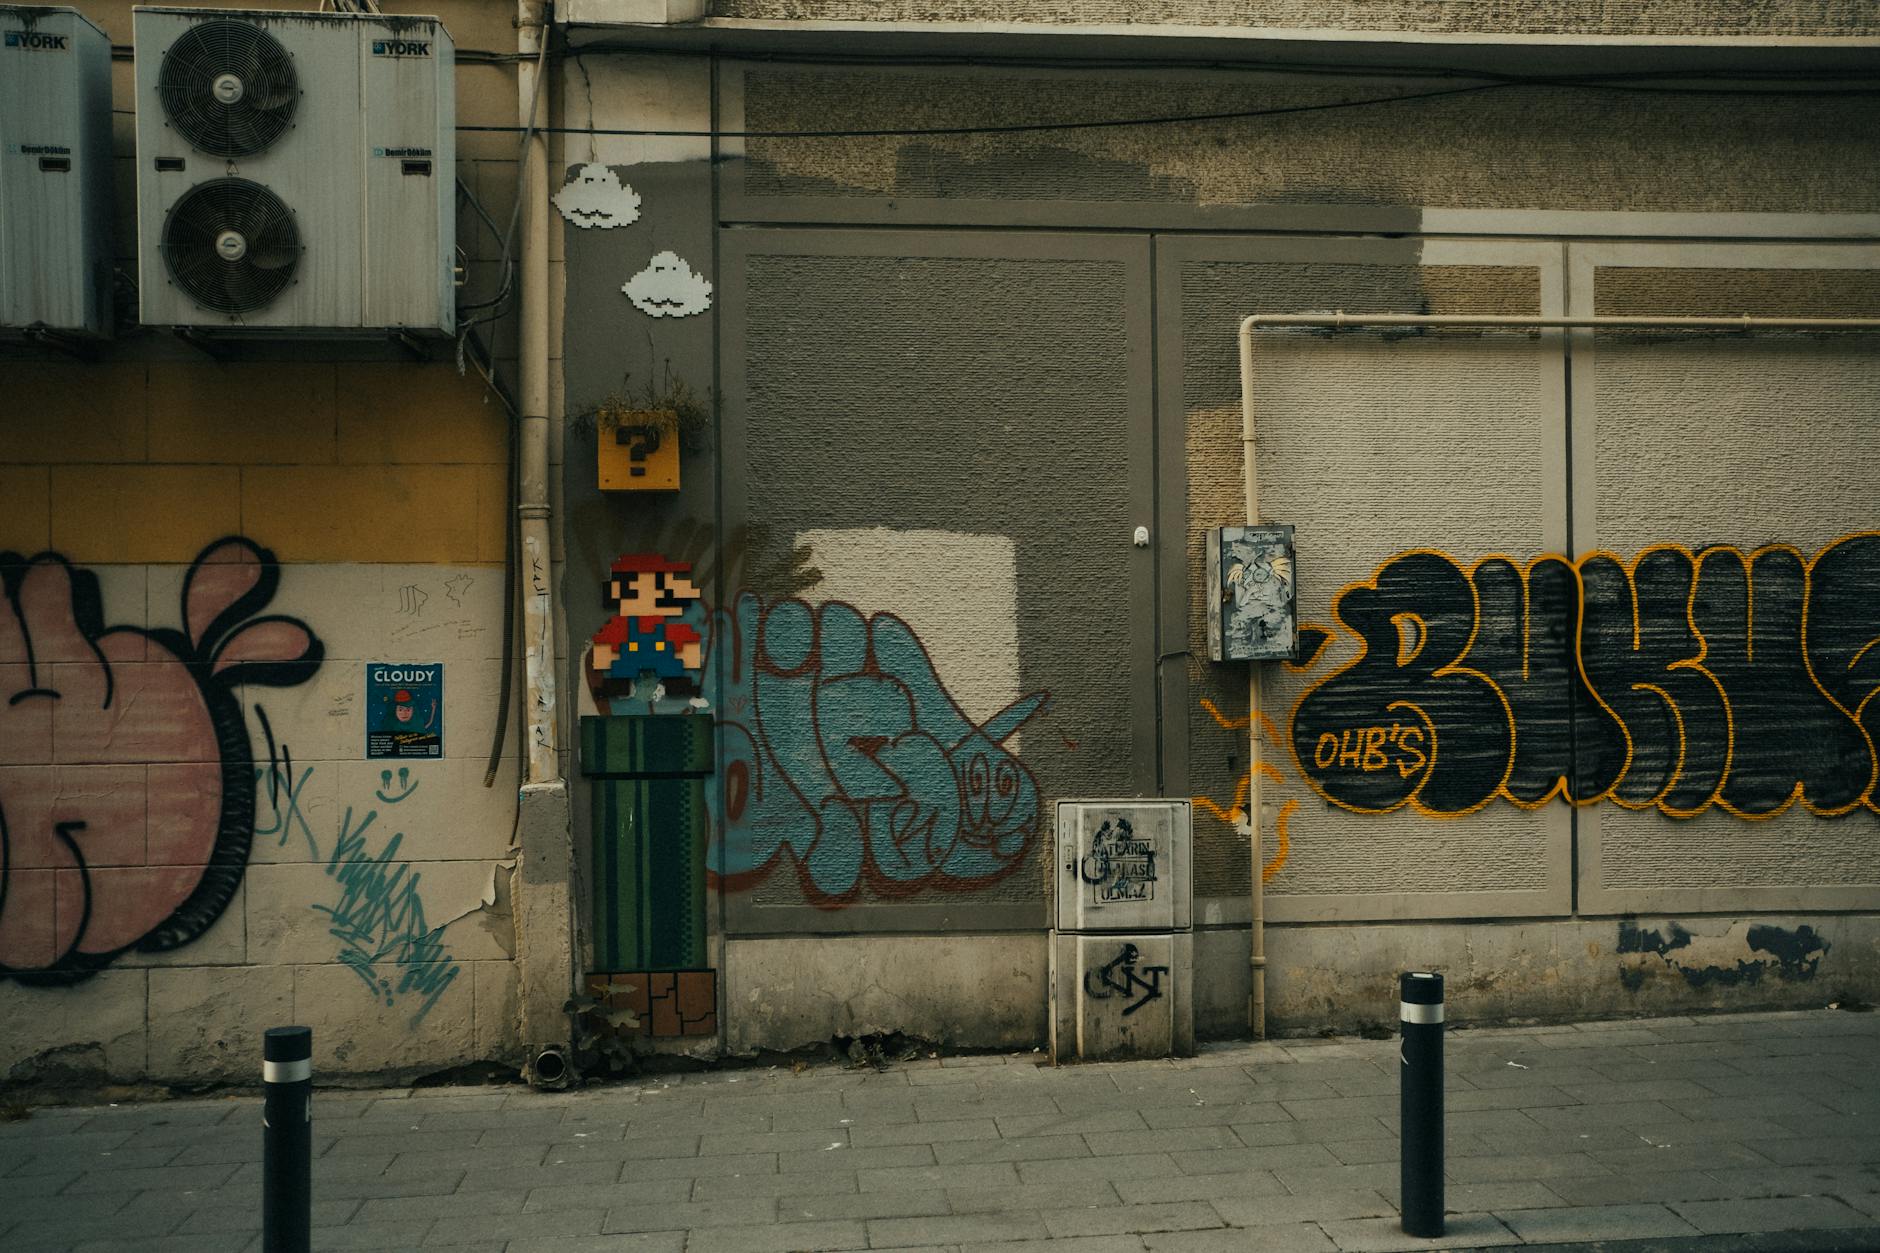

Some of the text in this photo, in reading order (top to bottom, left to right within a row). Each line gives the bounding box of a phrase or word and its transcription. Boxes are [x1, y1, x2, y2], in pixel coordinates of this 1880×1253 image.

[19, 34, 66, 50] YORK
[385, 42, 430, 56] YORK
[374, 670, 435, 682] CLOUDY
[1314, 722, 1427, 778] OHB'S
